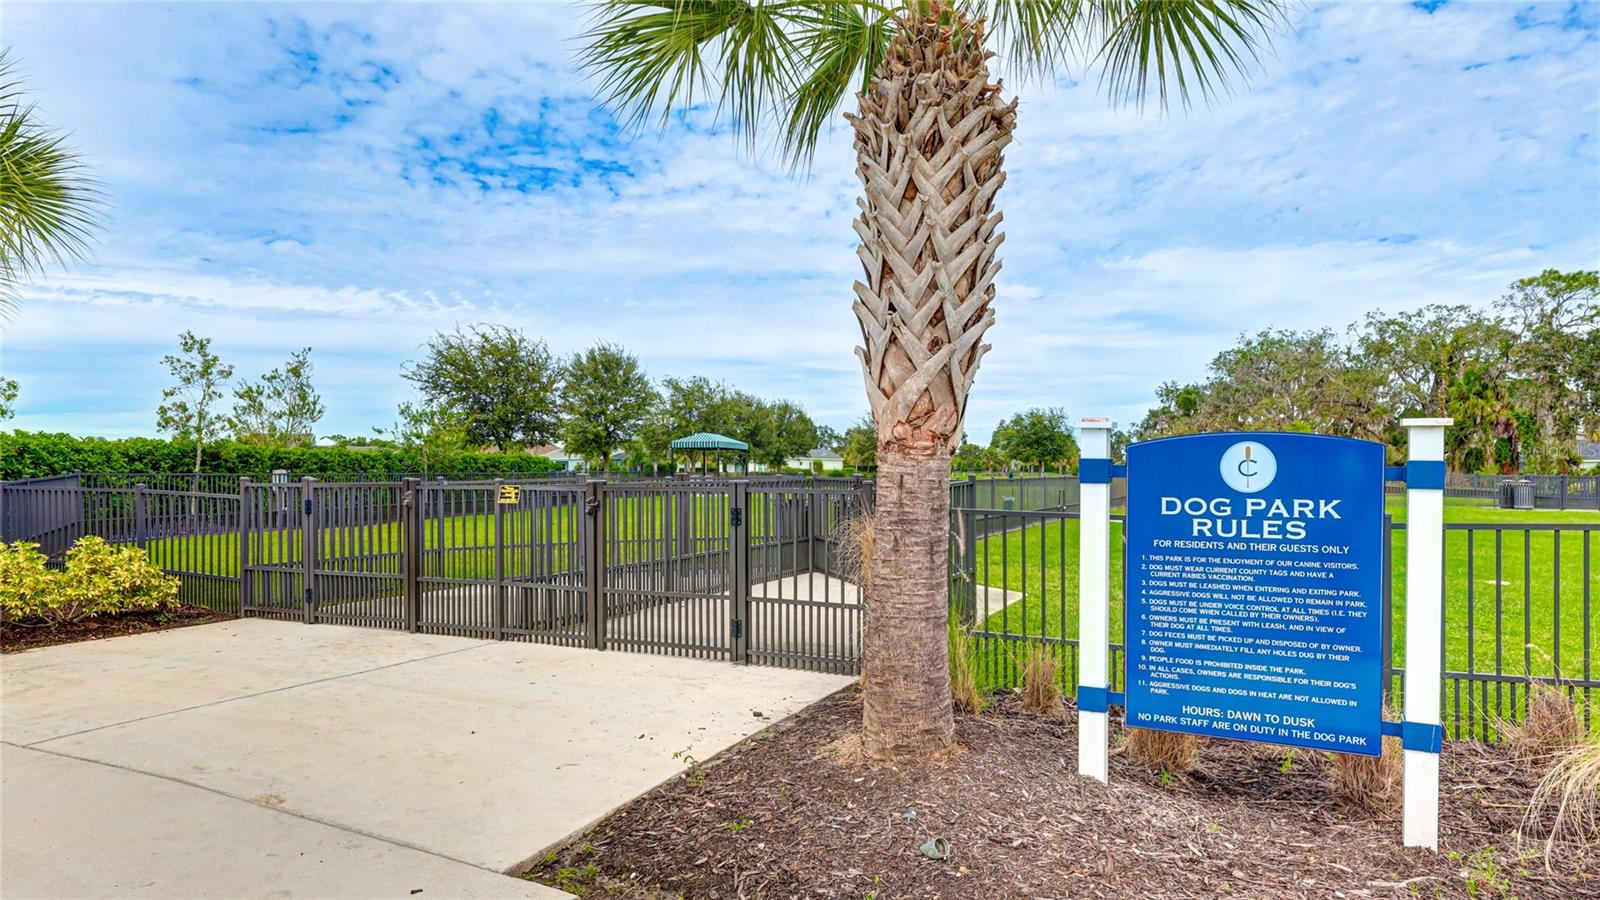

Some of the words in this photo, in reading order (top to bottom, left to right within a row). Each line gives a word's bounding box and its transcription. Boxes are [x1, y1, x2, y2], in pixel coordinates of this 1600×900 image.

[1161, 497, 1231, 516] DOG
[1246, 498, 1340, 519] PARK
[1193, 519, 1306, 540] RULES
[1174, 540, 1224, 549] RESIDENTS
[1227, 542, 1246, 550] AND
[1250, 543, 1277, 551] THEIR
[1279, 544, 1318, 553] GUESTS
[1322, 545, 1349, 554] ONLY
[1195, 644, 1238, 653] IMMEDIATELY
[1272, 640, 1307, 648] DISPOSED
[1204, 660, 1243, 669] PROHIBITED
[1197, 669, 1226, 678] OWNERS
[1244, 673, 1292, 683] RESPONSIBLE
[1150, 682, 1189, 691] AGGRESSIVE
[1311, 696, 1348, 706] ALLOWED
[1182, 705, 1223, 718] HOURS:
[1227, 710, 1261, 722] DAWN
[1265, 713, 1280, 724] TO
[1283, 715, 1314, 728] DUSK
[1138, 712, 1151, 722] NO
[1154, 714, 1177, 725] PARK
[1180, 717, 1209, 728] STAFF
[1212, 720, 1230, 730] ARE
[1233, 722, 1247, 732] ON
[1250, 724, 1275, 735] DUTY
[1278, 727, 1288, 737] IN
[1292, 728, 1310, 739] THE
[1314, 730, 1336, 742] DOG
[1339, 733, 1366, 745] PARK
